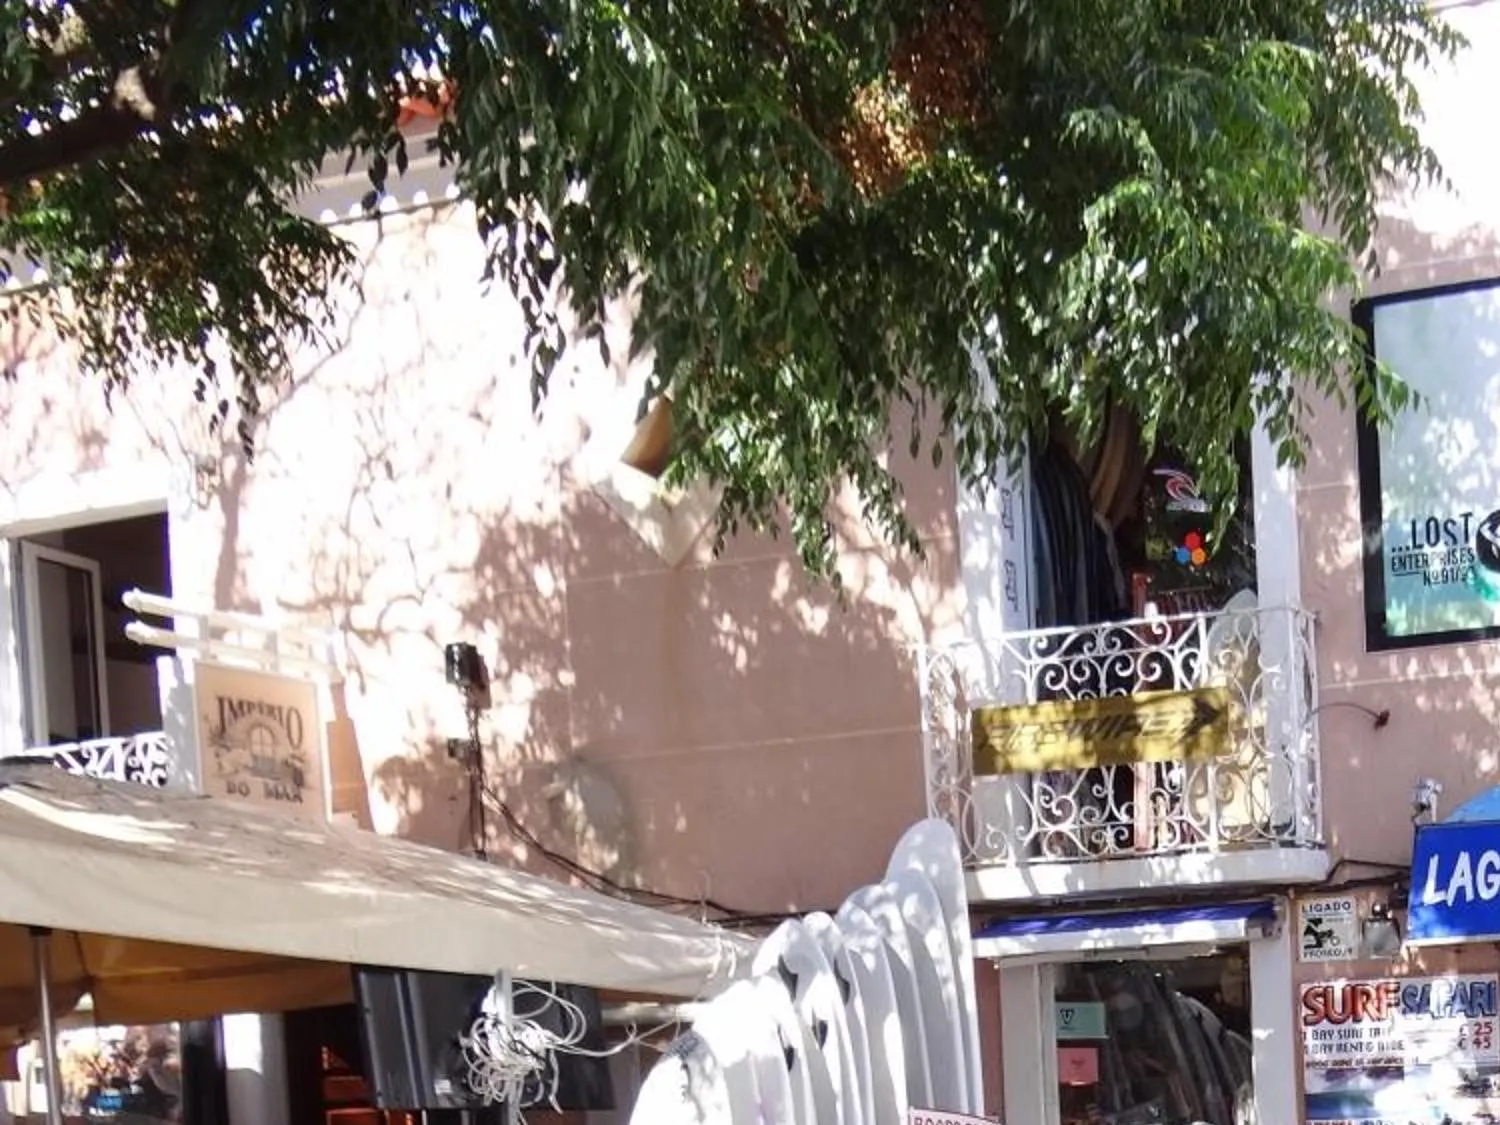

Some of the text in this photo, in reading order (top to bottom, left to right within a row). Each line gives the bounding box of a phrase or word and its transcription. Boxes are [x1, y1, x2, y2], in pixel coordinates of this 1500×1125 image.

[1302, 901, 1351, 912] LIGADO
[1303, 980, 1498, 1026] SURF SAFARI
[1474, 1021, 1493, 1037] 25
[1473, 1035, 1492, 1049] 45
